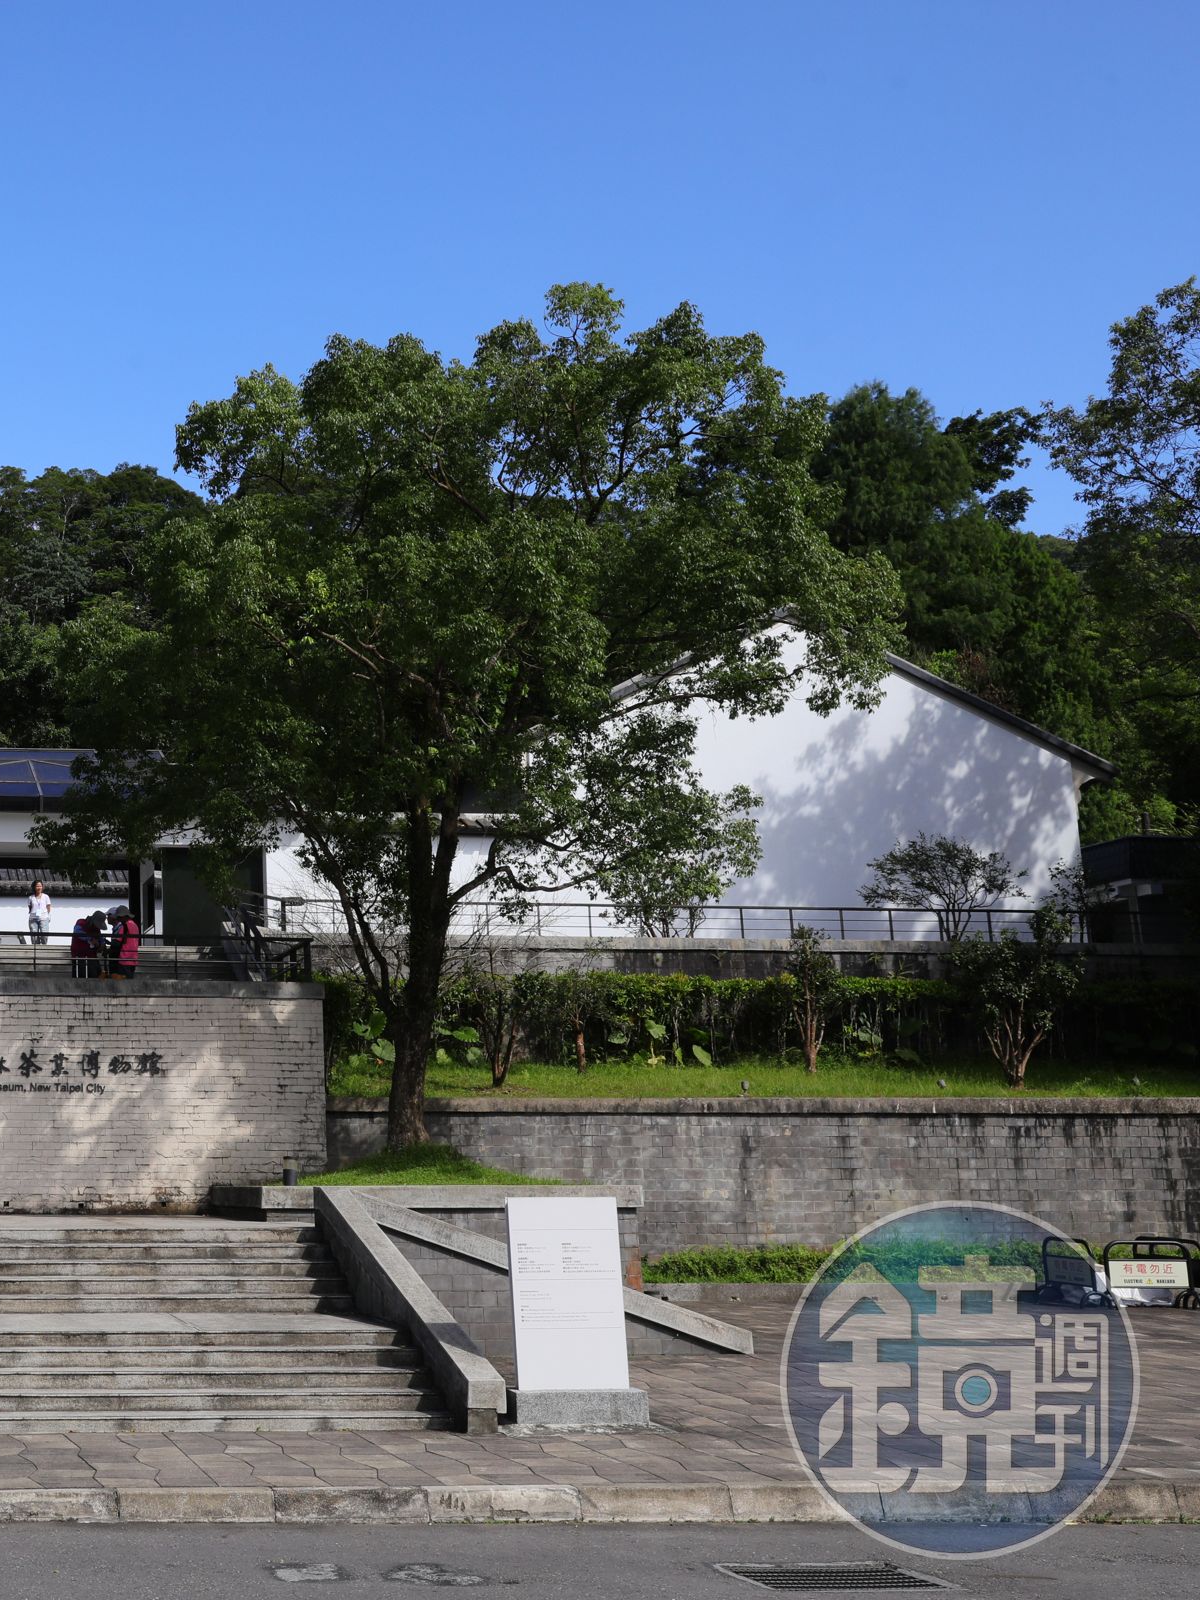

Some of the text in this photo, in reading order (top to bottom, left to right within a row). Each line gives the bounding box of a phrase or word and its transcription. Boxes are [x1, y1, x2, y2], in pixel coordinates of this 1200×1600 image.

[29, 1082, 51, 1092] New
[54, 1083, 84, 1094] Taipei
[86, 1083, 106, 1095] City
[1122, 1263, 1174, 1274] 有電勿近
